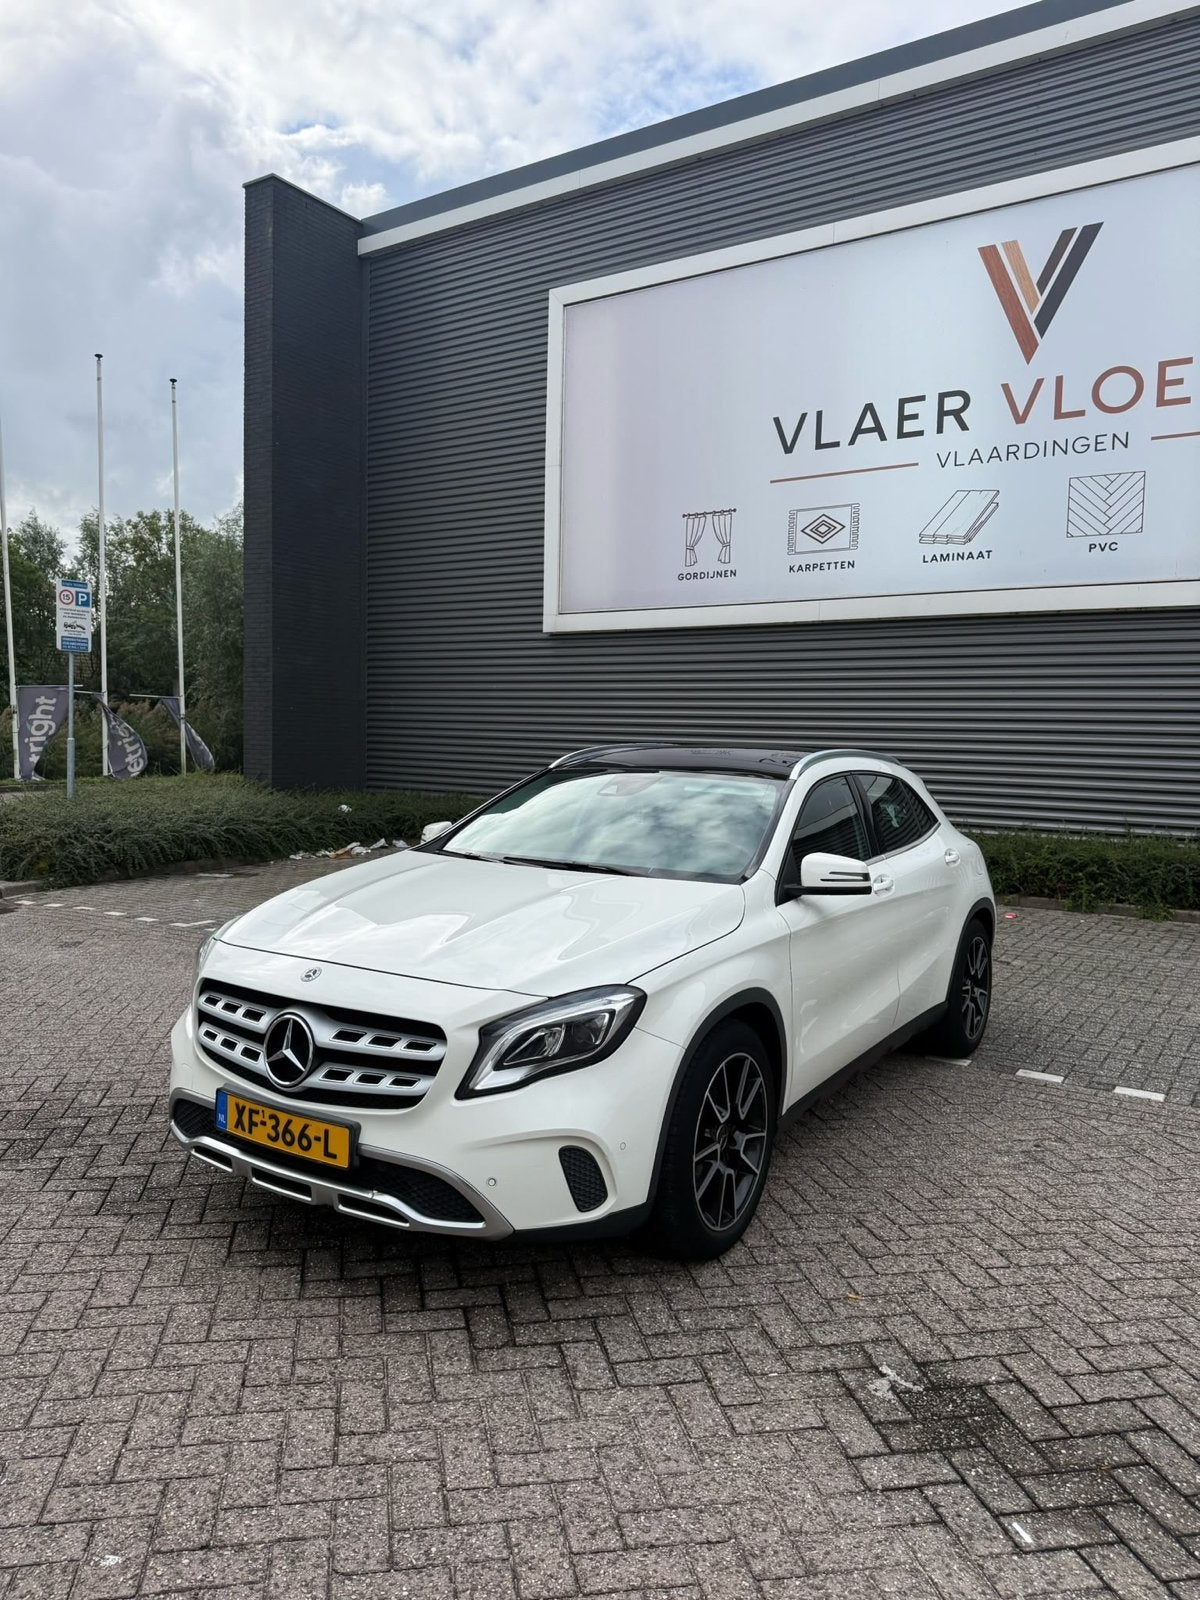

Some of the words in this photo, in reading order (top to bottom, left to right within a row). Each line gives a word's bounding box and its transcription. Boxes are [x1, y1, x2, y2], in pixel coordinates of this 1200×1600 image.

[773, 389, 971, 455] VLAER
[1001, 356, 1194, 425] VLOE
[936, 432, 1130, 469] VLAARDINGEN
[1088, 541, 1119, 553] PVC
[922, 550, 993, 564] LAMINAAT
[788, 559, 856, 573] KARPETTEN
[677, 568, 737, 582] GORDIJNEN
[78, 593, 88, 605] P
[218, 1112, 226, 1124] NL
[234, 1101, 338, 1160] XF-366-L
